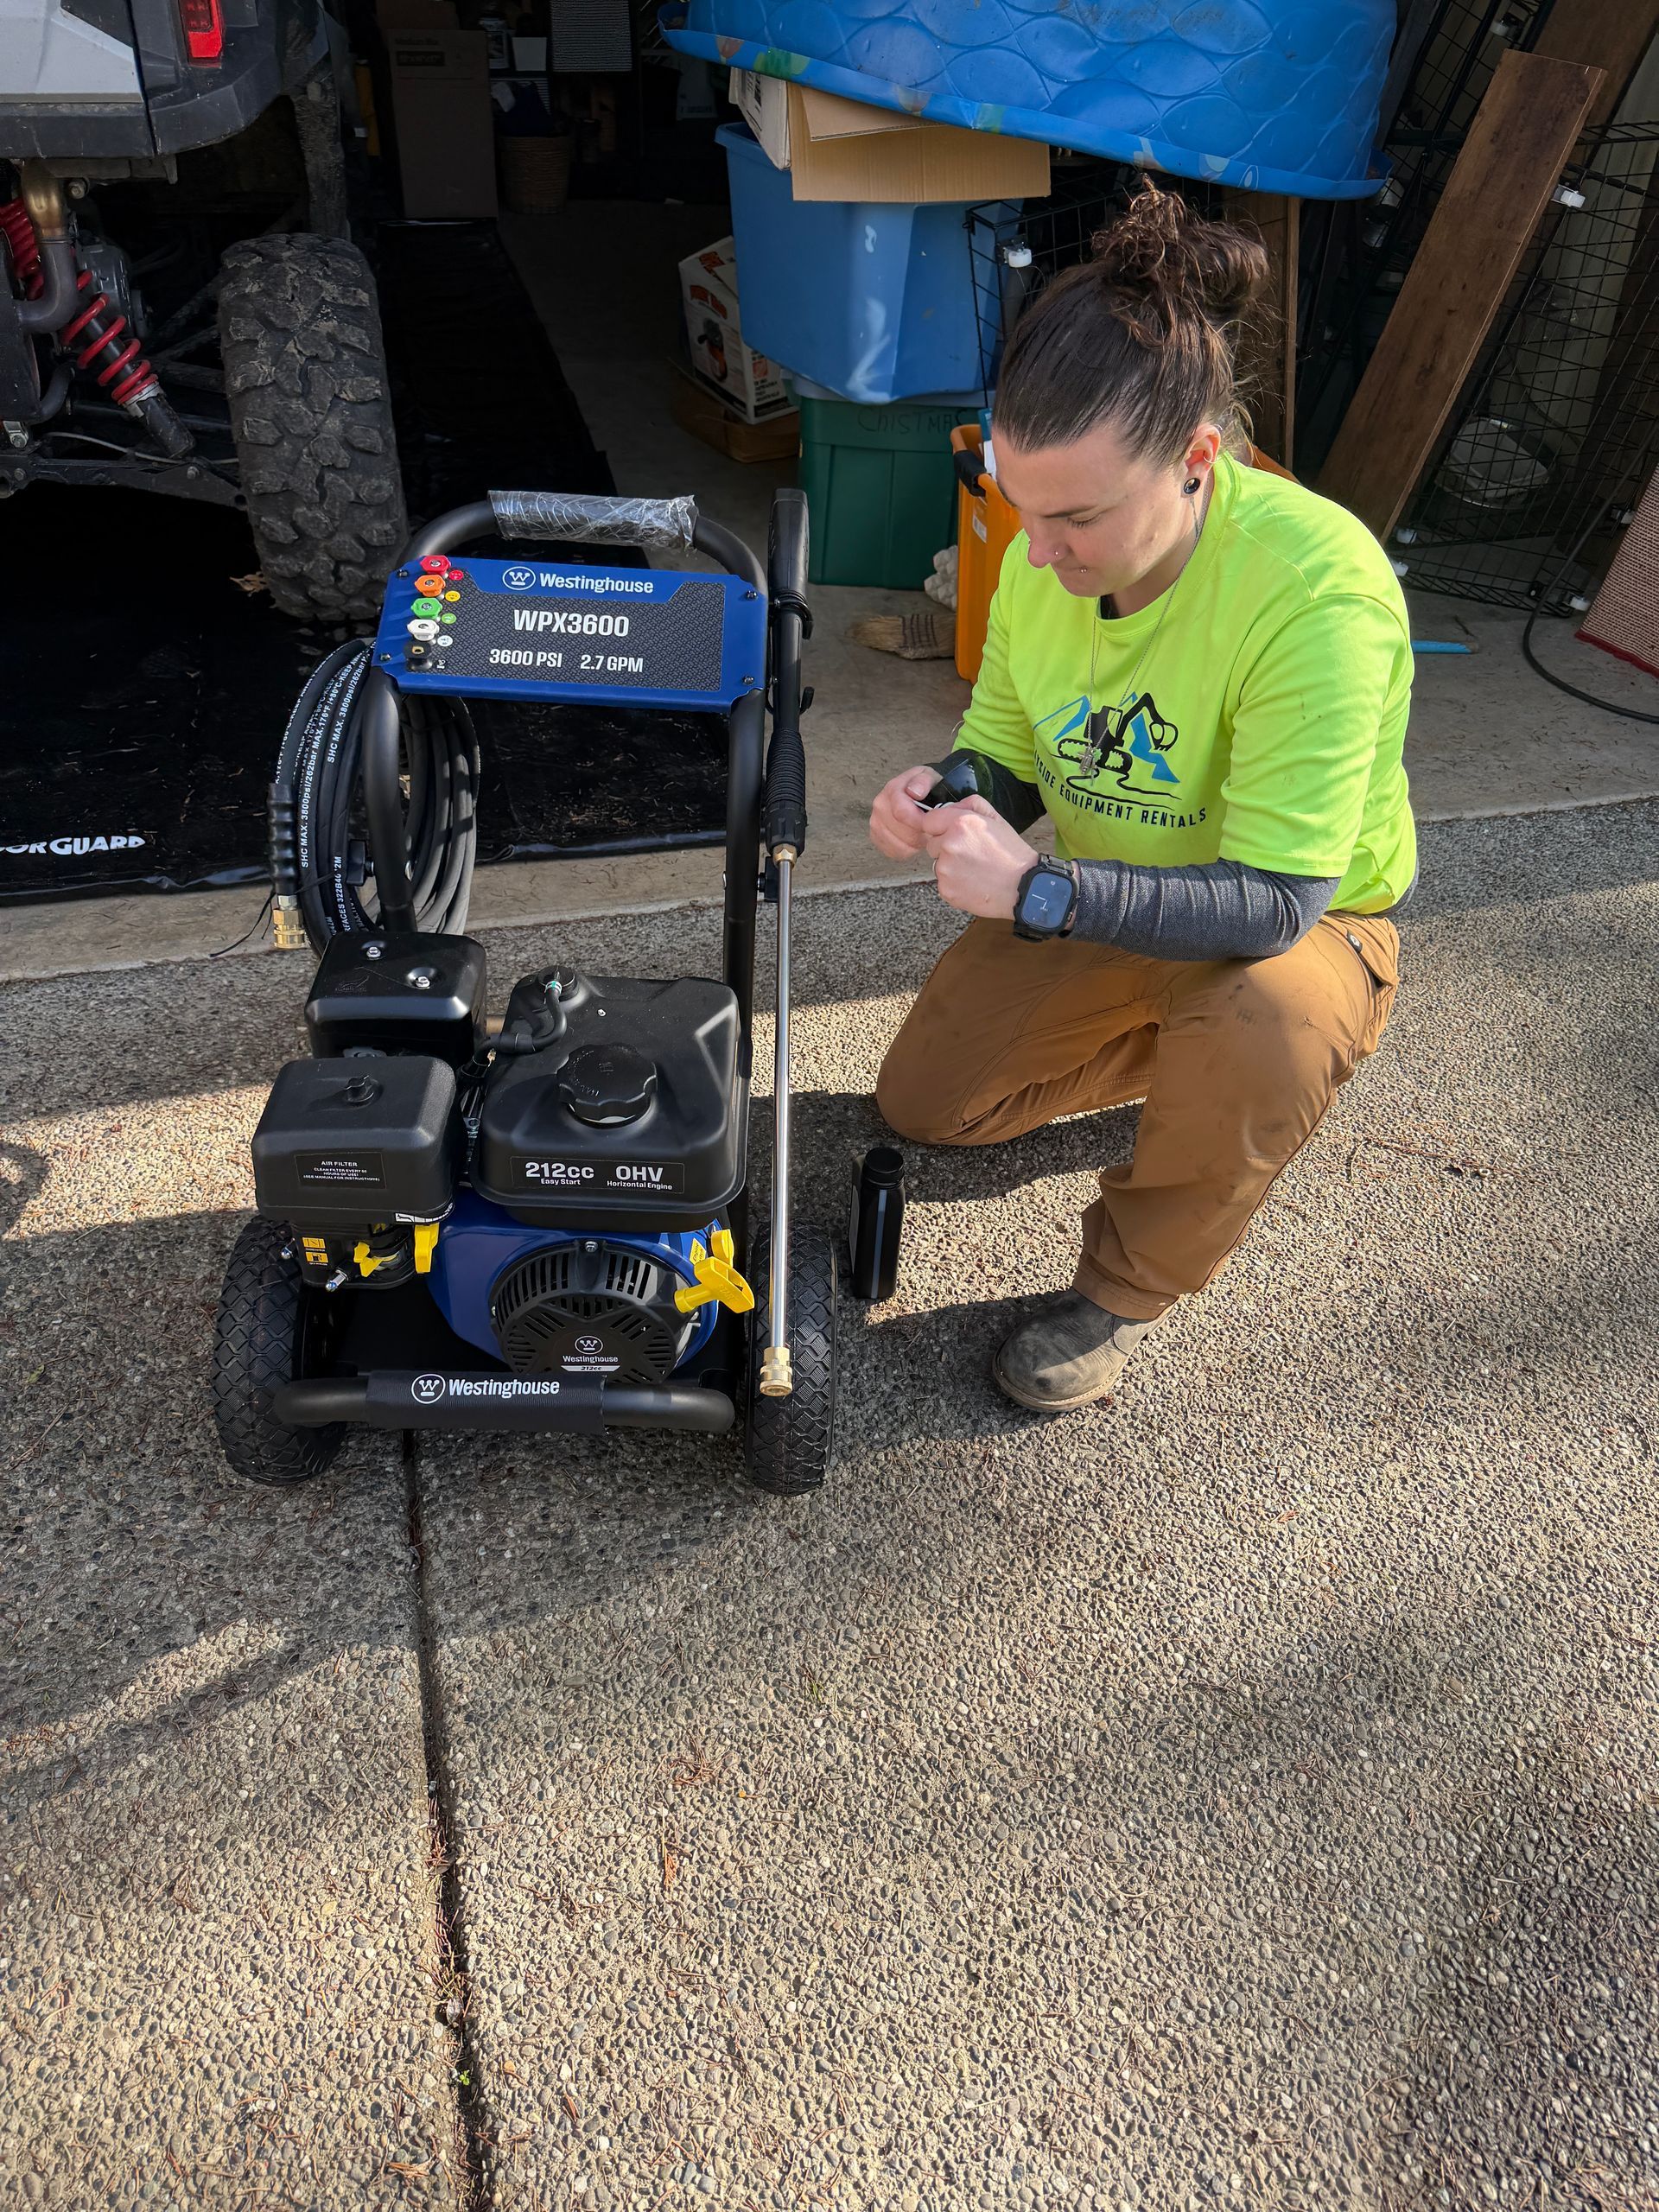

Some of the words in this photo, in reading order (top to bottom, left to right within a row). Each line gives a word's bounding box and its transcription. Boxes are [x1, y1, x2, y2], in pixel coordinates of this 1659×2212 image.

[539, 572, 654, 594] Westinghouse
[513, 609, 630, 637] WPX3600
[489, 649, 533, 665] 3600
[536, 652, 563, 668] PSI
[580, 654, 605, 671] 2.7
[607, 656, 644, 672] GPM
[327, 742, 338, 763] SHC
[1059, 785, 1133, 820] EQUIPMENT
[1141, 808, 1206, 828] RENTALS
[300, 822, 308, 846] MAX.
[524, 1161, 594, 1179] 212cc
[615, 1166, 664, 1182] OHV
[647, 1182, 672, 1191] Engine
[563, 1355, 619, 1363] Westinghouse
[448, 1378, 560, 1399] Westinghouse
